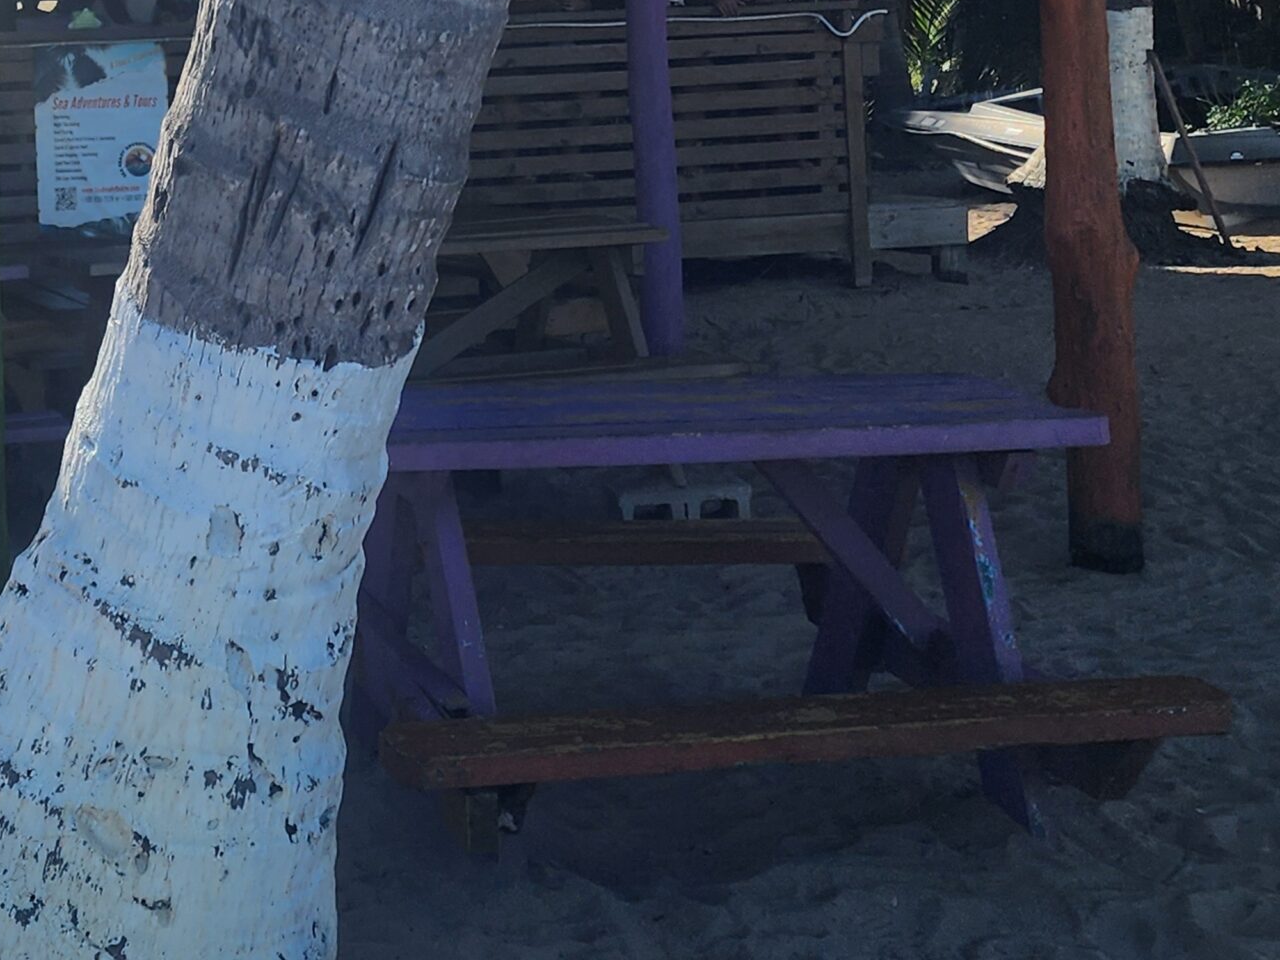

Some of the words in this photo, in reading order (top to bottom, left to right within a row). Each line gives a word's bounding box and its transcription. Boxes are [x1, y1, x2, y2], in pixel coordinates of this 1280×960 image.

[70, 95, 121, 109] Adventures
[124, 94, 130, 108] &
[133, 94, 158, 108] Tours
